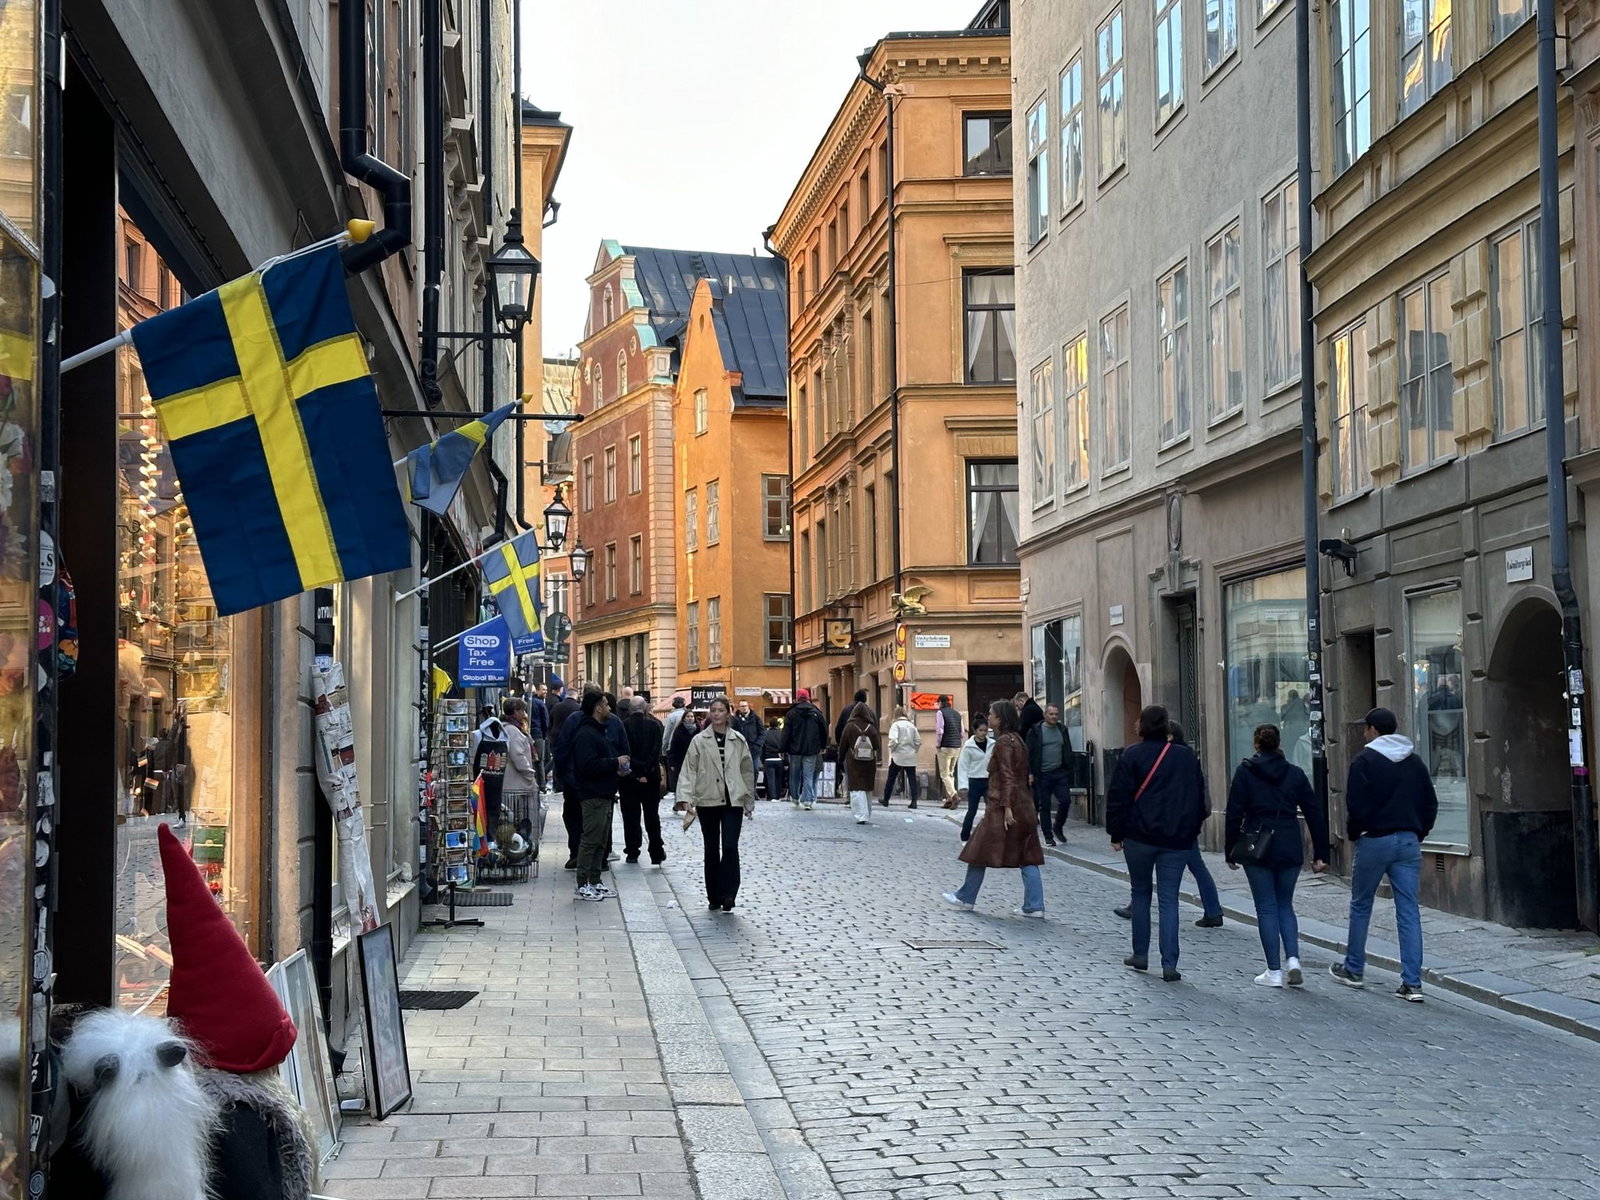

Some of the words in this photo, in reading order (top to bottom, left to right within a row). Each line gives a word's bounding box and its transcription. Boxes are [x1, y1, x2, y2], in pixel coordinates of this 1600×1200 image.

[467, 636, 497, 647] Shop
[467, 648, 487, 657] Tax
[469, 657, 495, 666] Free
[693, 690, 706, 699] CAFÉ
